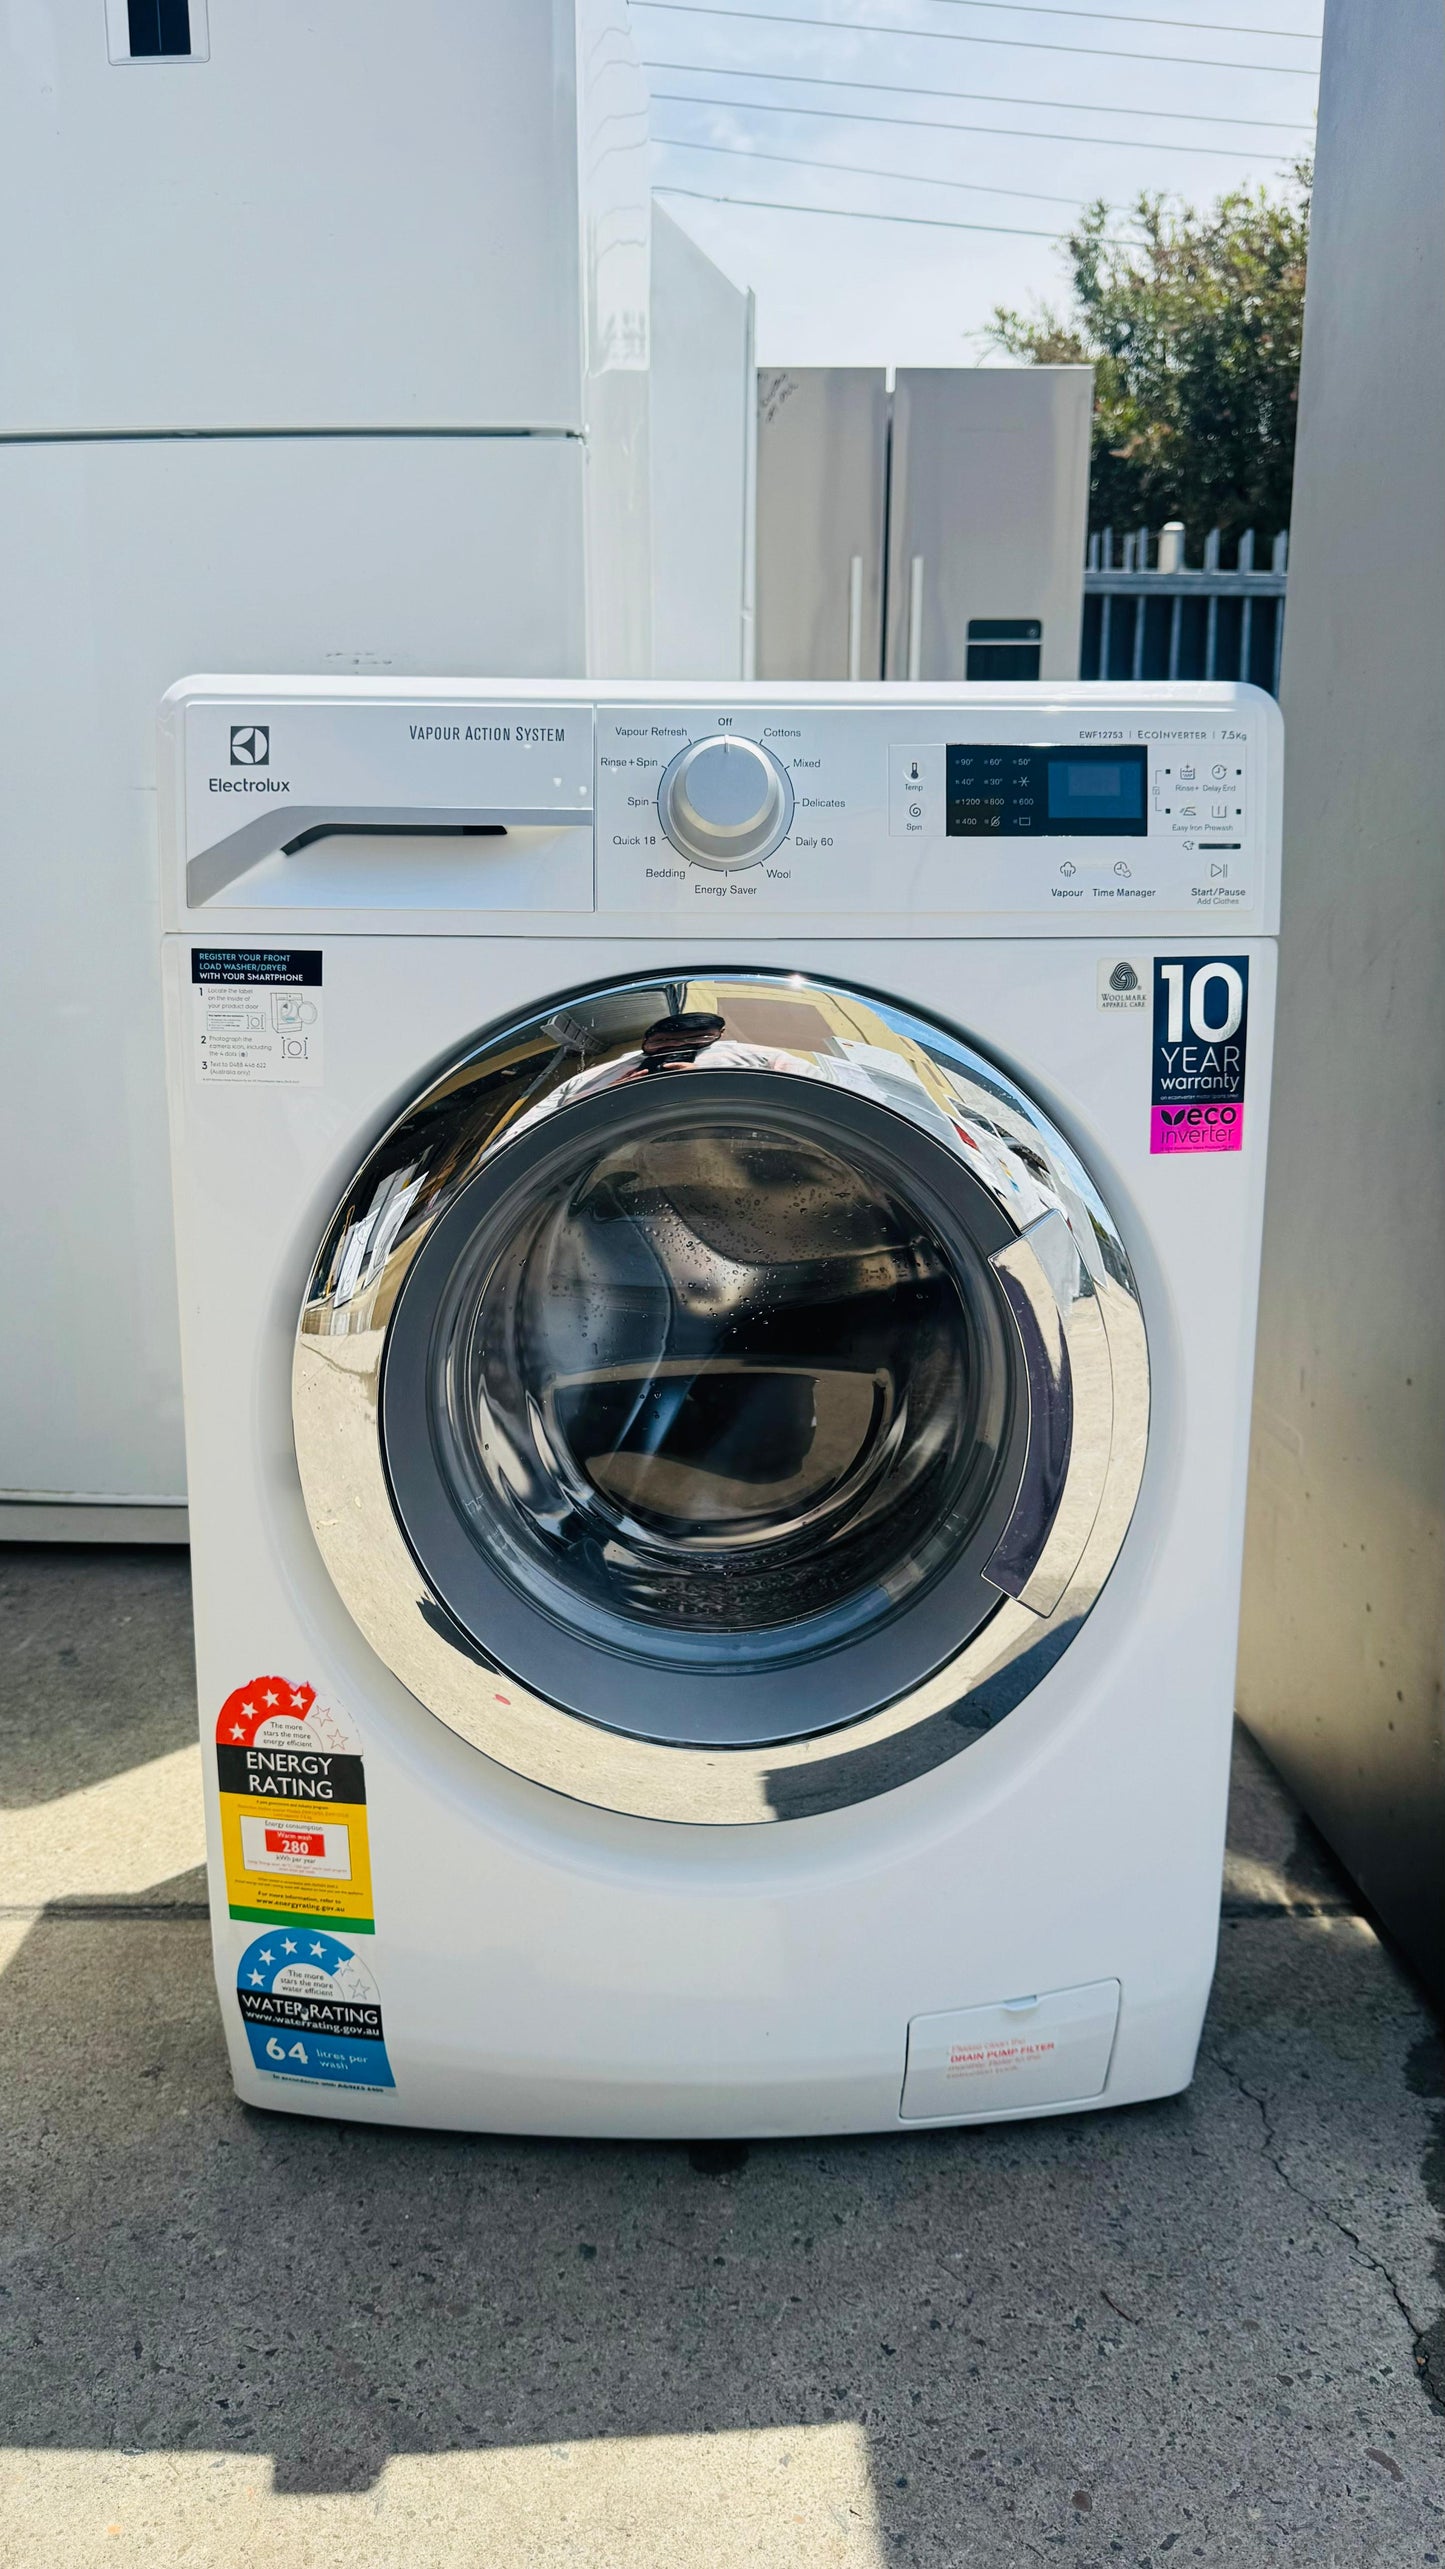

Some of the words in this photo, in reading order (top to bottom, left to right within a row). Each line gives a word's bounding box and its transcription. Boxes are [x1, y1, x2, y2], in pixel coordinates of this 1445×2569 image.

[718, 718, 732, 726] Off
[409, 725, 460, 741] VAPOUR
[465, 726, 511, 742] ACTION
[516, 726, 566, 743] SYSTEM
[615, 727, 648, 737] Vapour
[652, 727, 688, 736] Refresh
[764, 728, 802, 738] Cottons
[1079, 731, 1124, 739] EWF12753
[793, 758, 820, 768] Mixed
[209, 778, 290, 793] Electrolux
[905, 784, 923, 792] Temp
[1202, 784, 1221, 793] Delay
[1222, 784, 1236, 792] End
[627, 797, 649, 808] Spin
[802, 798, 846, 808] Delicates
[962, 798, 980, 806] 1200
[990, 798, 1004, 806] 800
[1018, 798, 1034, 806] 600
[906, 824, 922, 832] Spin
[1172, 824, 1188, 832] Easy
[1190, 824, 1202, 832] Iron
[612, 836, 640, 846] Quick
[644, 836, 656, 845] 18
[796, 837, 818, 848] Daily
[820, 837, 834, 846] 60
[646, 868, 686, 880] Bedding
[766, 870, 792, 878] Wool
[694, 885, 727, 897] Energy
[730, 885, 757, 895] Saver
[1051, 888, 1084, 898] Vapour
[1092, 888, 1114, 897] Time
[1116, 888, 1156, 898] Manager
[1191, 888, 1246, 898] Start/Pause
[199, 953, 236, 961] REGISTER
[238, 954, 261, 962] YOUR
[263, 954, 291, 962] FRONT
[199, 962, 222, 970] LOAD
[223, 963, 287, 972] WASHER/DRYER
[200, 972, 220, 980] WITH
[247, 974, 304, 982] SMARTPHONE
[200, 988, 203, 996] 1
[1101, 994, 1148, 1002] WOOLMARK
[1161, 962, 1244, 1044] 10
[200, 1036, 206, 1044] 2
[246, 1044, 272, 1052] including
[1160, 1046, 1240, 1074] YEAR
[202, 1061, 208, 1070] 3
[1160, 1073, 1240, 1092] warranty
[1186, 1106, 1237, 1126] eco
[1161, 1125, 1236, 1144] inverter
[270, 1722, 282, 1730] The
[284, 1723, 303, 1731] more
[264, 1730, 279, 1738] stars
[280, 1730, 292, 1738] the
[294, 1732, 311, 1740] more
[263, 1738, 285, 1748] energy
[286, 1739, 313, 1748] efficient
[246, 1751, 333, 1776] ENERGY
[250, 1774, 334, 1800] RATING
[265, 1820, 284, 1829] Energy
[286, 1822, 323, 1832] consumption
[277, 1831, 297, 1839] Warm
[298, 1833, 313, 1841] wash
[282, 1840, 309, 1854] 280
[276, 1854, 291, 1862] kWh
[292, 1856, 302, 1864] per
[256, 1898, 345, 1912] www.energyrating.gov.au
[288, 1969, 302, 1978] The
[304, 1972, 324, 1981] more
[280, 1976, 298, 1986] stars
[300, 1978, 312, 1987] the
[314, 1981, 334, 1989] more
[282, 1986, 302, 1994] water
[304, 1988, 334, 1998] efficient
[310, 2004, 378, 2024] RATING
[245, 2010, 380, 2036] www.waterrating.gov.au
[266, 2037, 309, 2065] 64
[316, 2048, 345, 2060] litres
[348, 2054, 368, 2064] per
[950, 2052, 984, 2064] DRAIN
[986, 2048, 1018, 2059] PUMP
[1020, 2041, 1054, 2054] FILTER
[320, 2060, 348, 2070] wash
